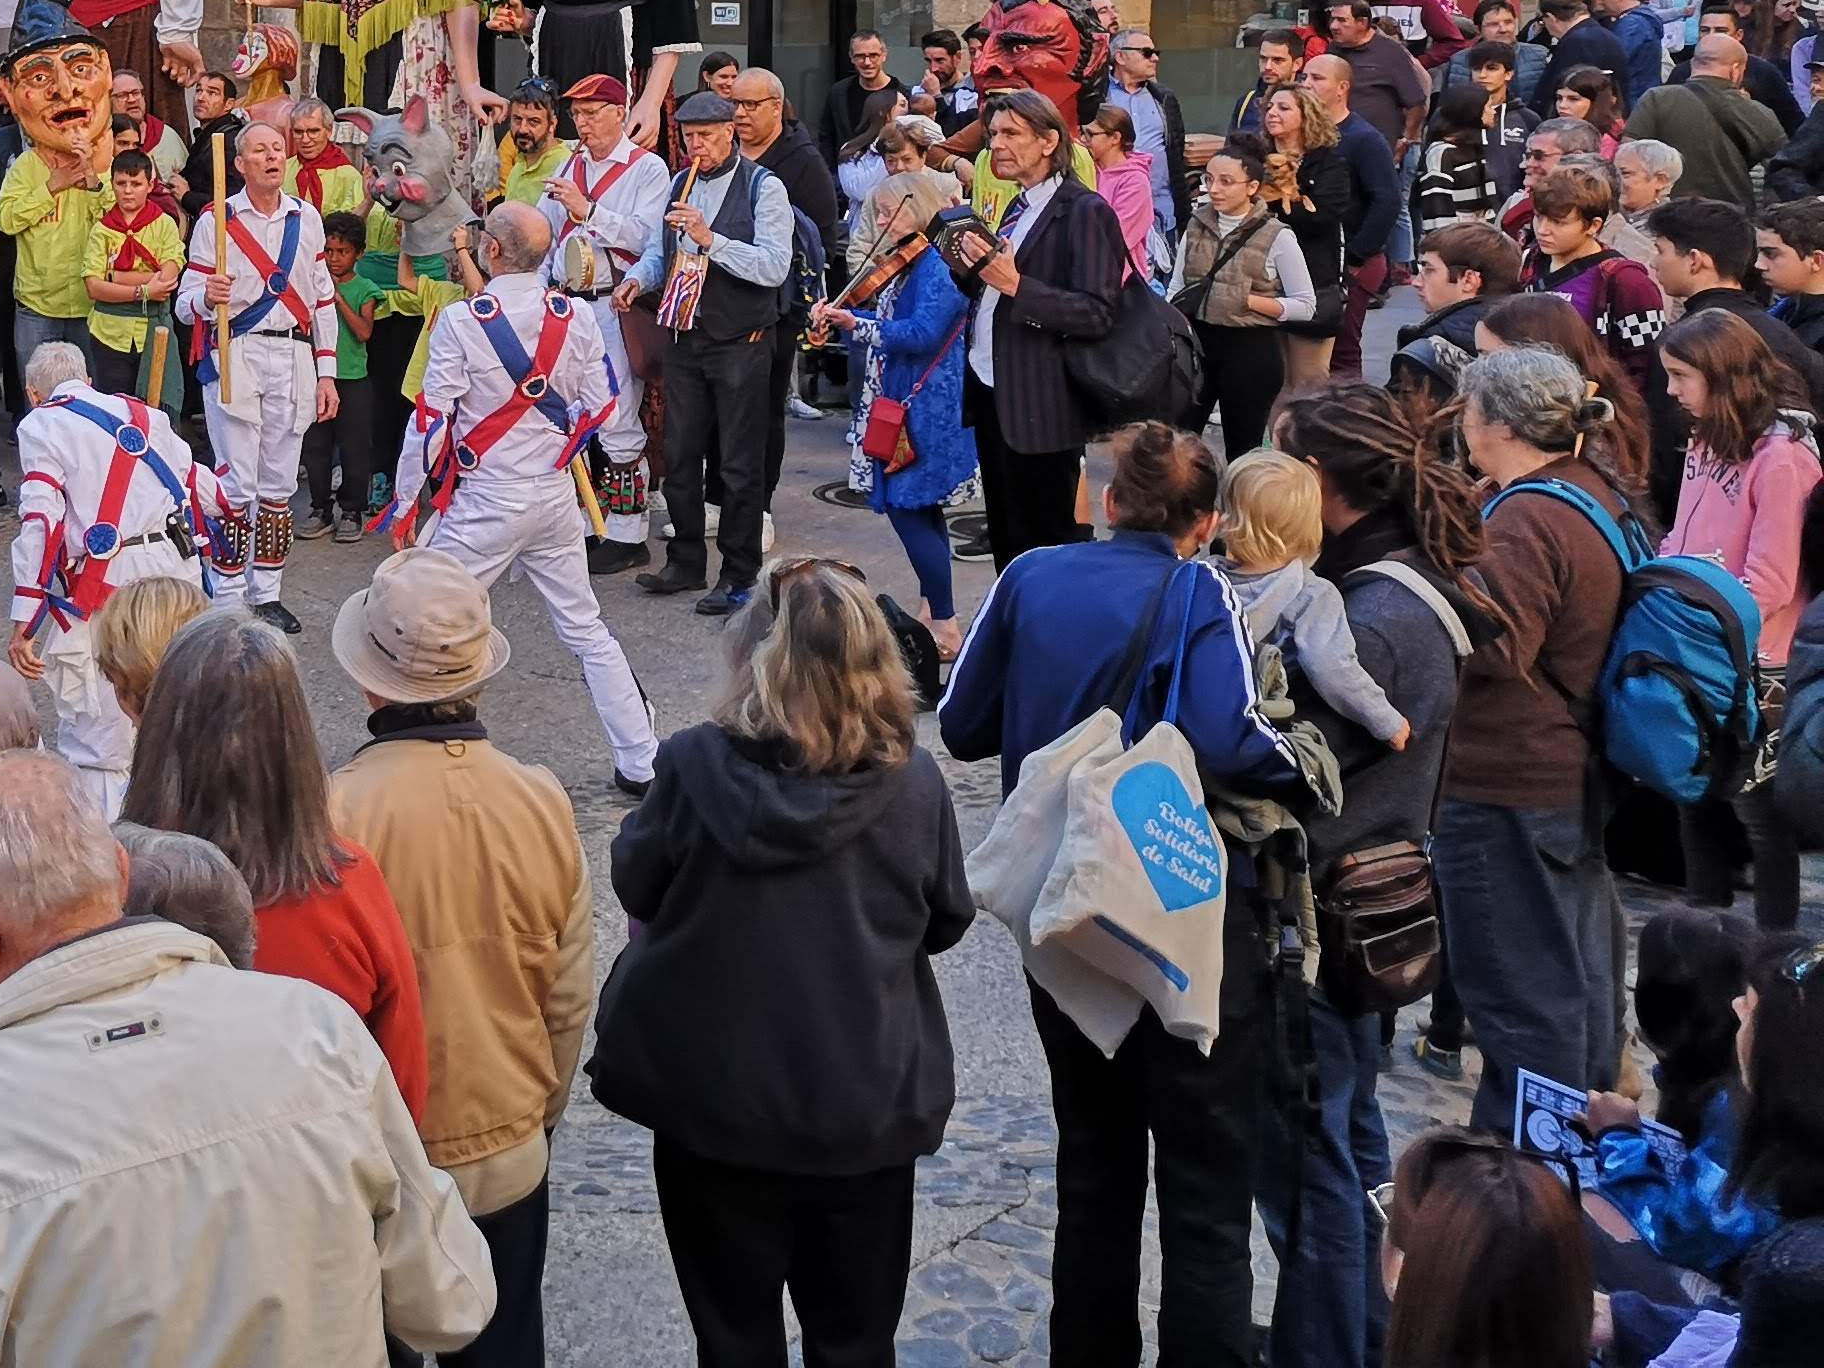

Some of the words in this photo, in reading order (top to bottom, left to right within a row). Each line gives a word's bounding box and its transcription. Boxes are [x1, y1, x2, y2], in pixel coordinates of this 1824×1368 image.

[1159, 801, 1213, 849] Botiga
[1142, 844, 1164, 865] de
[1167, 857, 1212, 893] Salut
